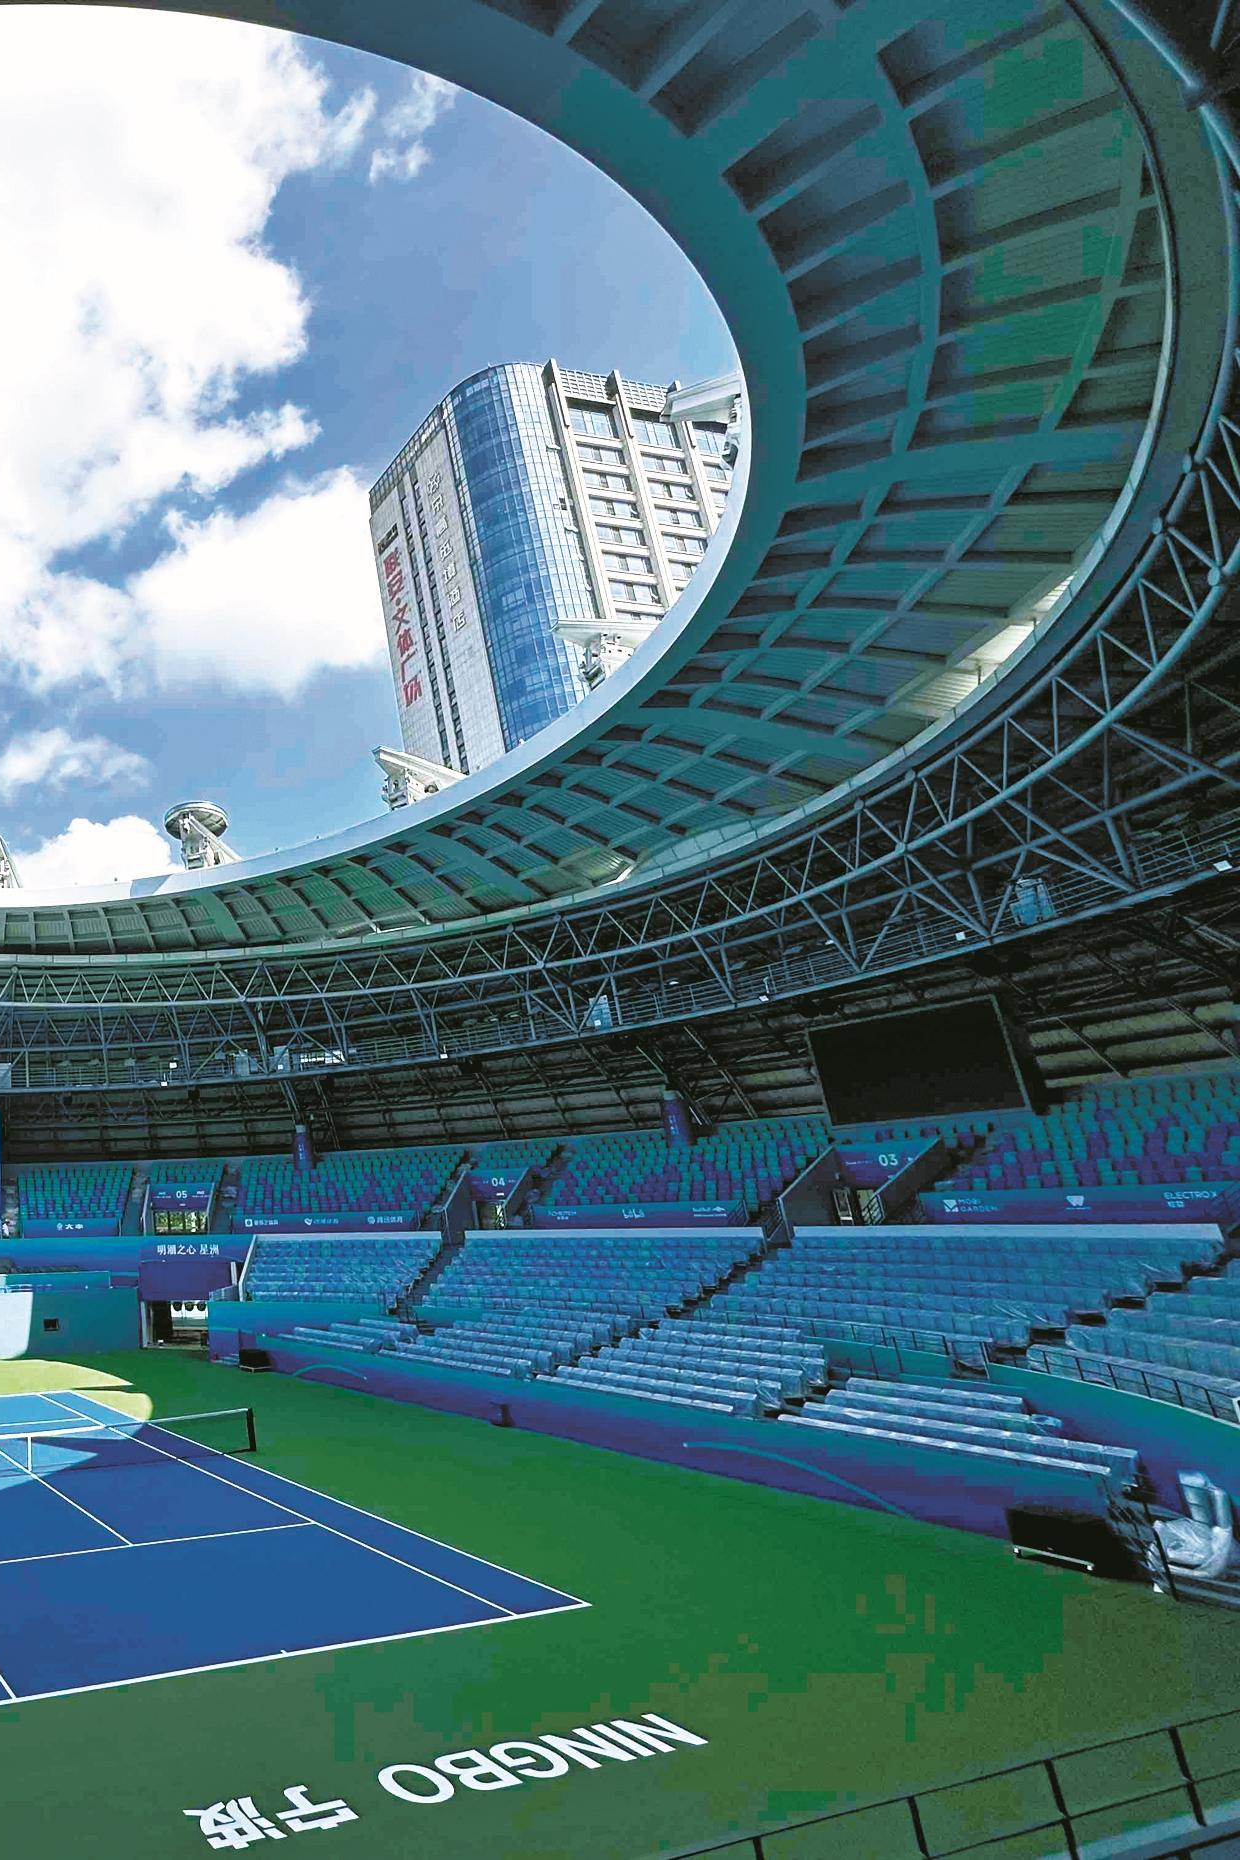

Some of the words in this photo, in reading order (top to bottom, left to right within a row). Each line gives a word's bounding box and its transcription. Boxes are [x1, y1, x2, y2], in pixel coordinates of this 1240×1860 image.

[878, 1153, 898, 1167] 03
[491, 1177, 505, 1187] 04
[175, 1190, 188, 1199] 05
[377, 1713, 709, 1804] NINGBO
[182, 1784, 360, 1850] 宁波
